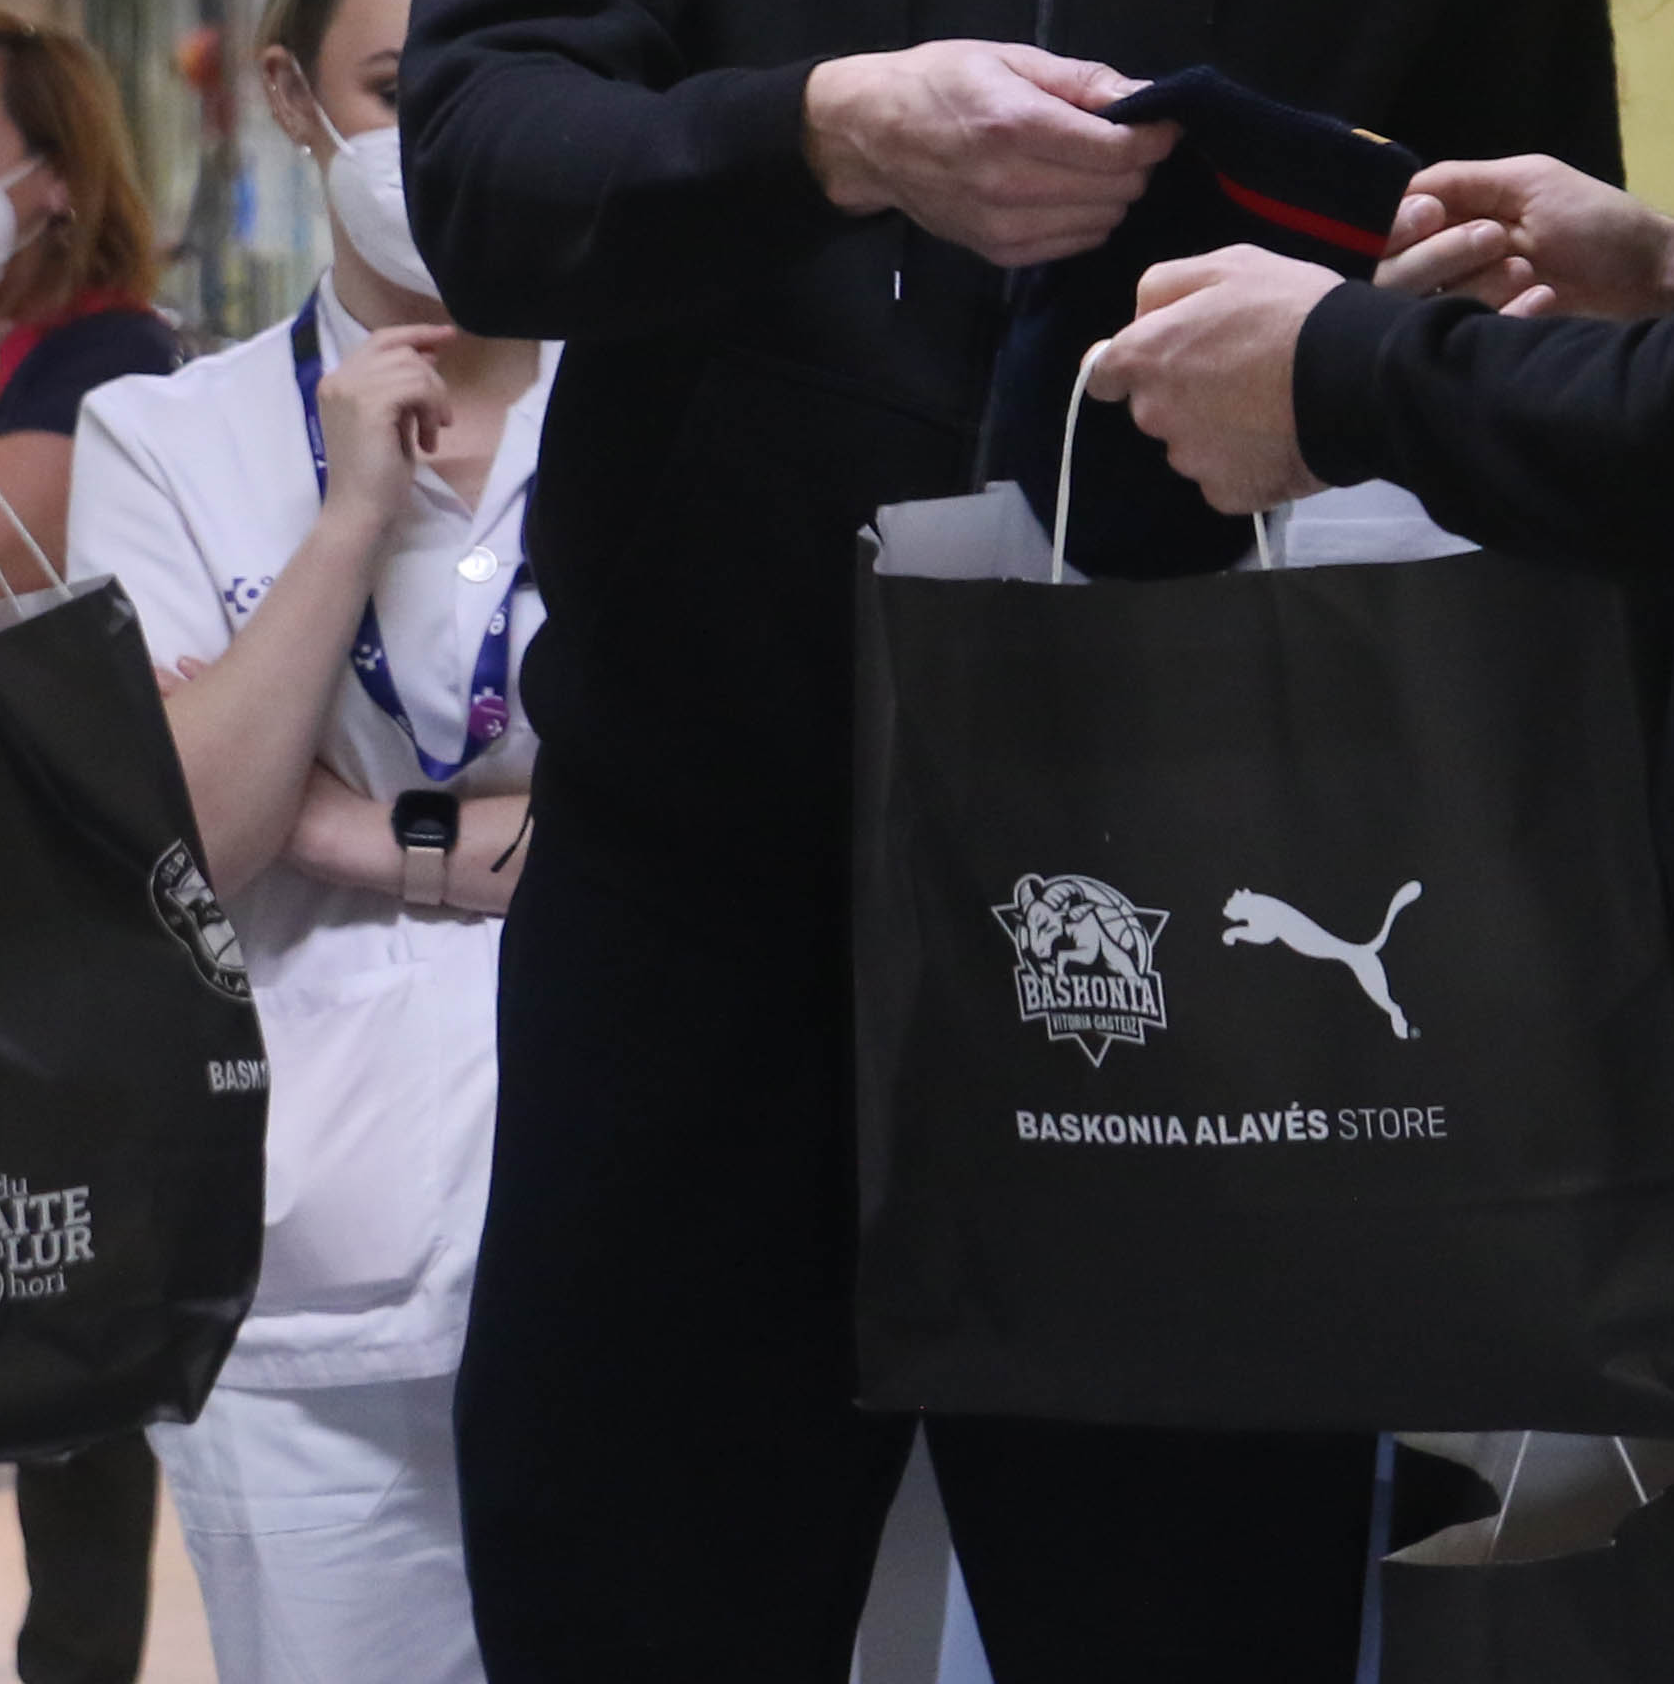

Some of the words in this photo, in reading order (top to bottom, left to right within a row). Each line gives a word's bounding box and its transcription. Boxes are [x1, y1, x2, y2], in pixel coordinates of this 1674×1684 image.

[1021, 973, 1159, 1017] BASKONIA
[1016, 1110, 1188, 1145] BASKONIA
[1194, 1101, 1328, 1145] ALAVÉS
[1337, 1106, 1448, 1140] STORE
[7, 1225, 95, 1271] LUR
[9, 1266, 67, 1297] hori
